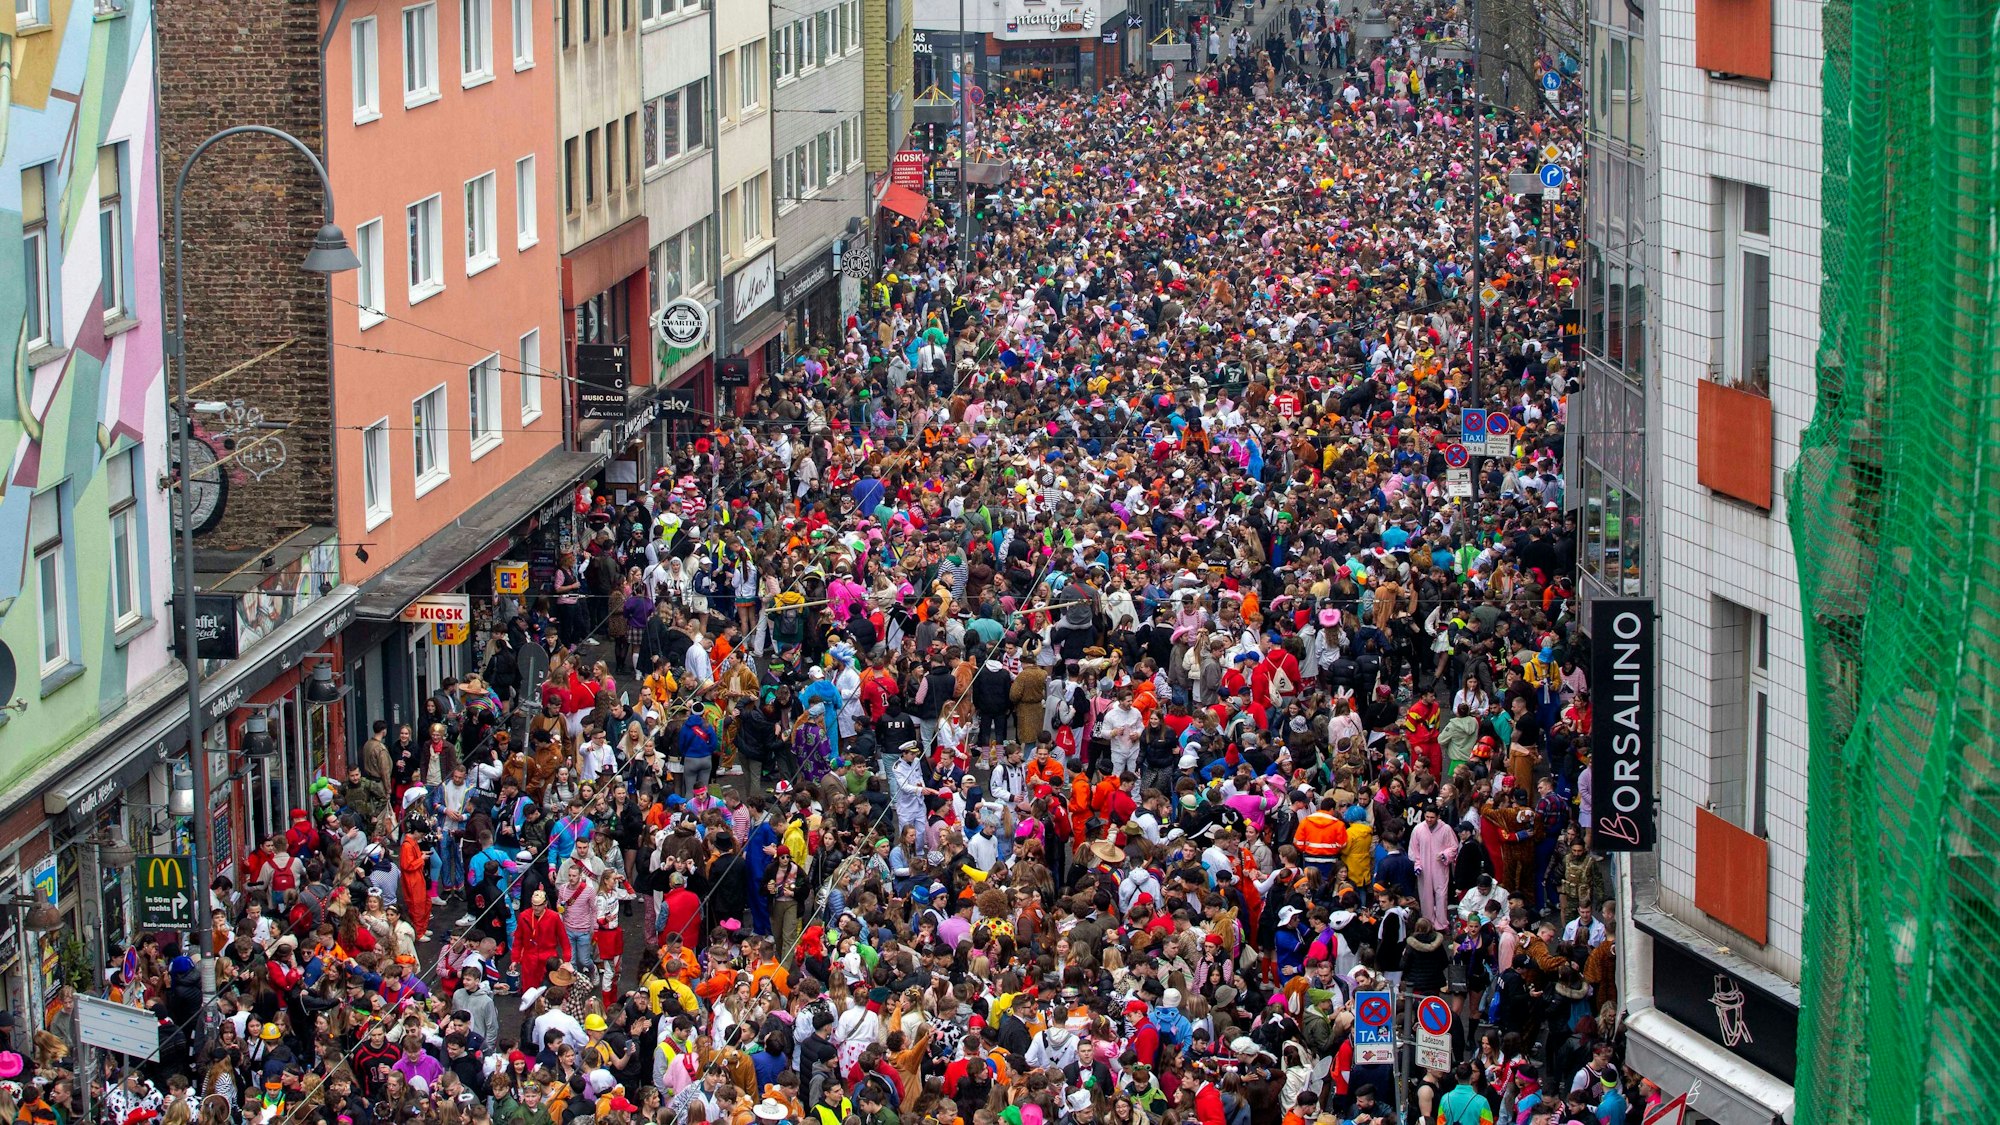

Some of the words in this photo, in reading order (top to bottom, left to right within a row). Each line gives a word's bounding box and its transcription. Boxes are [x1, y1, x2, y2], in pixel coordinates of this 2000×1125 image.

[1015, 9, 1074, 32] mangal
[893, 154, 921, 162] KIOSK
[661, 319, 703, 328] KWARTIER
[582, 394, 604, 402] MUSIC
[605, 394, 624, 402] CLUB
[663, 396, 689, 413] sky
[1280, 403, 1292, 416] 15
[1464, 433, 1484, 442] TAXI
[420, 608, 463, 620] KIOSK
[196, 615, 218, 629] affel
[887, 721, 905, 729] FBI
[1599, 611, 1642, 845] BORSALINO
[1407, 807, 1423, 826] 84
[1422, 1034, 1445, 1047] Ladezone
